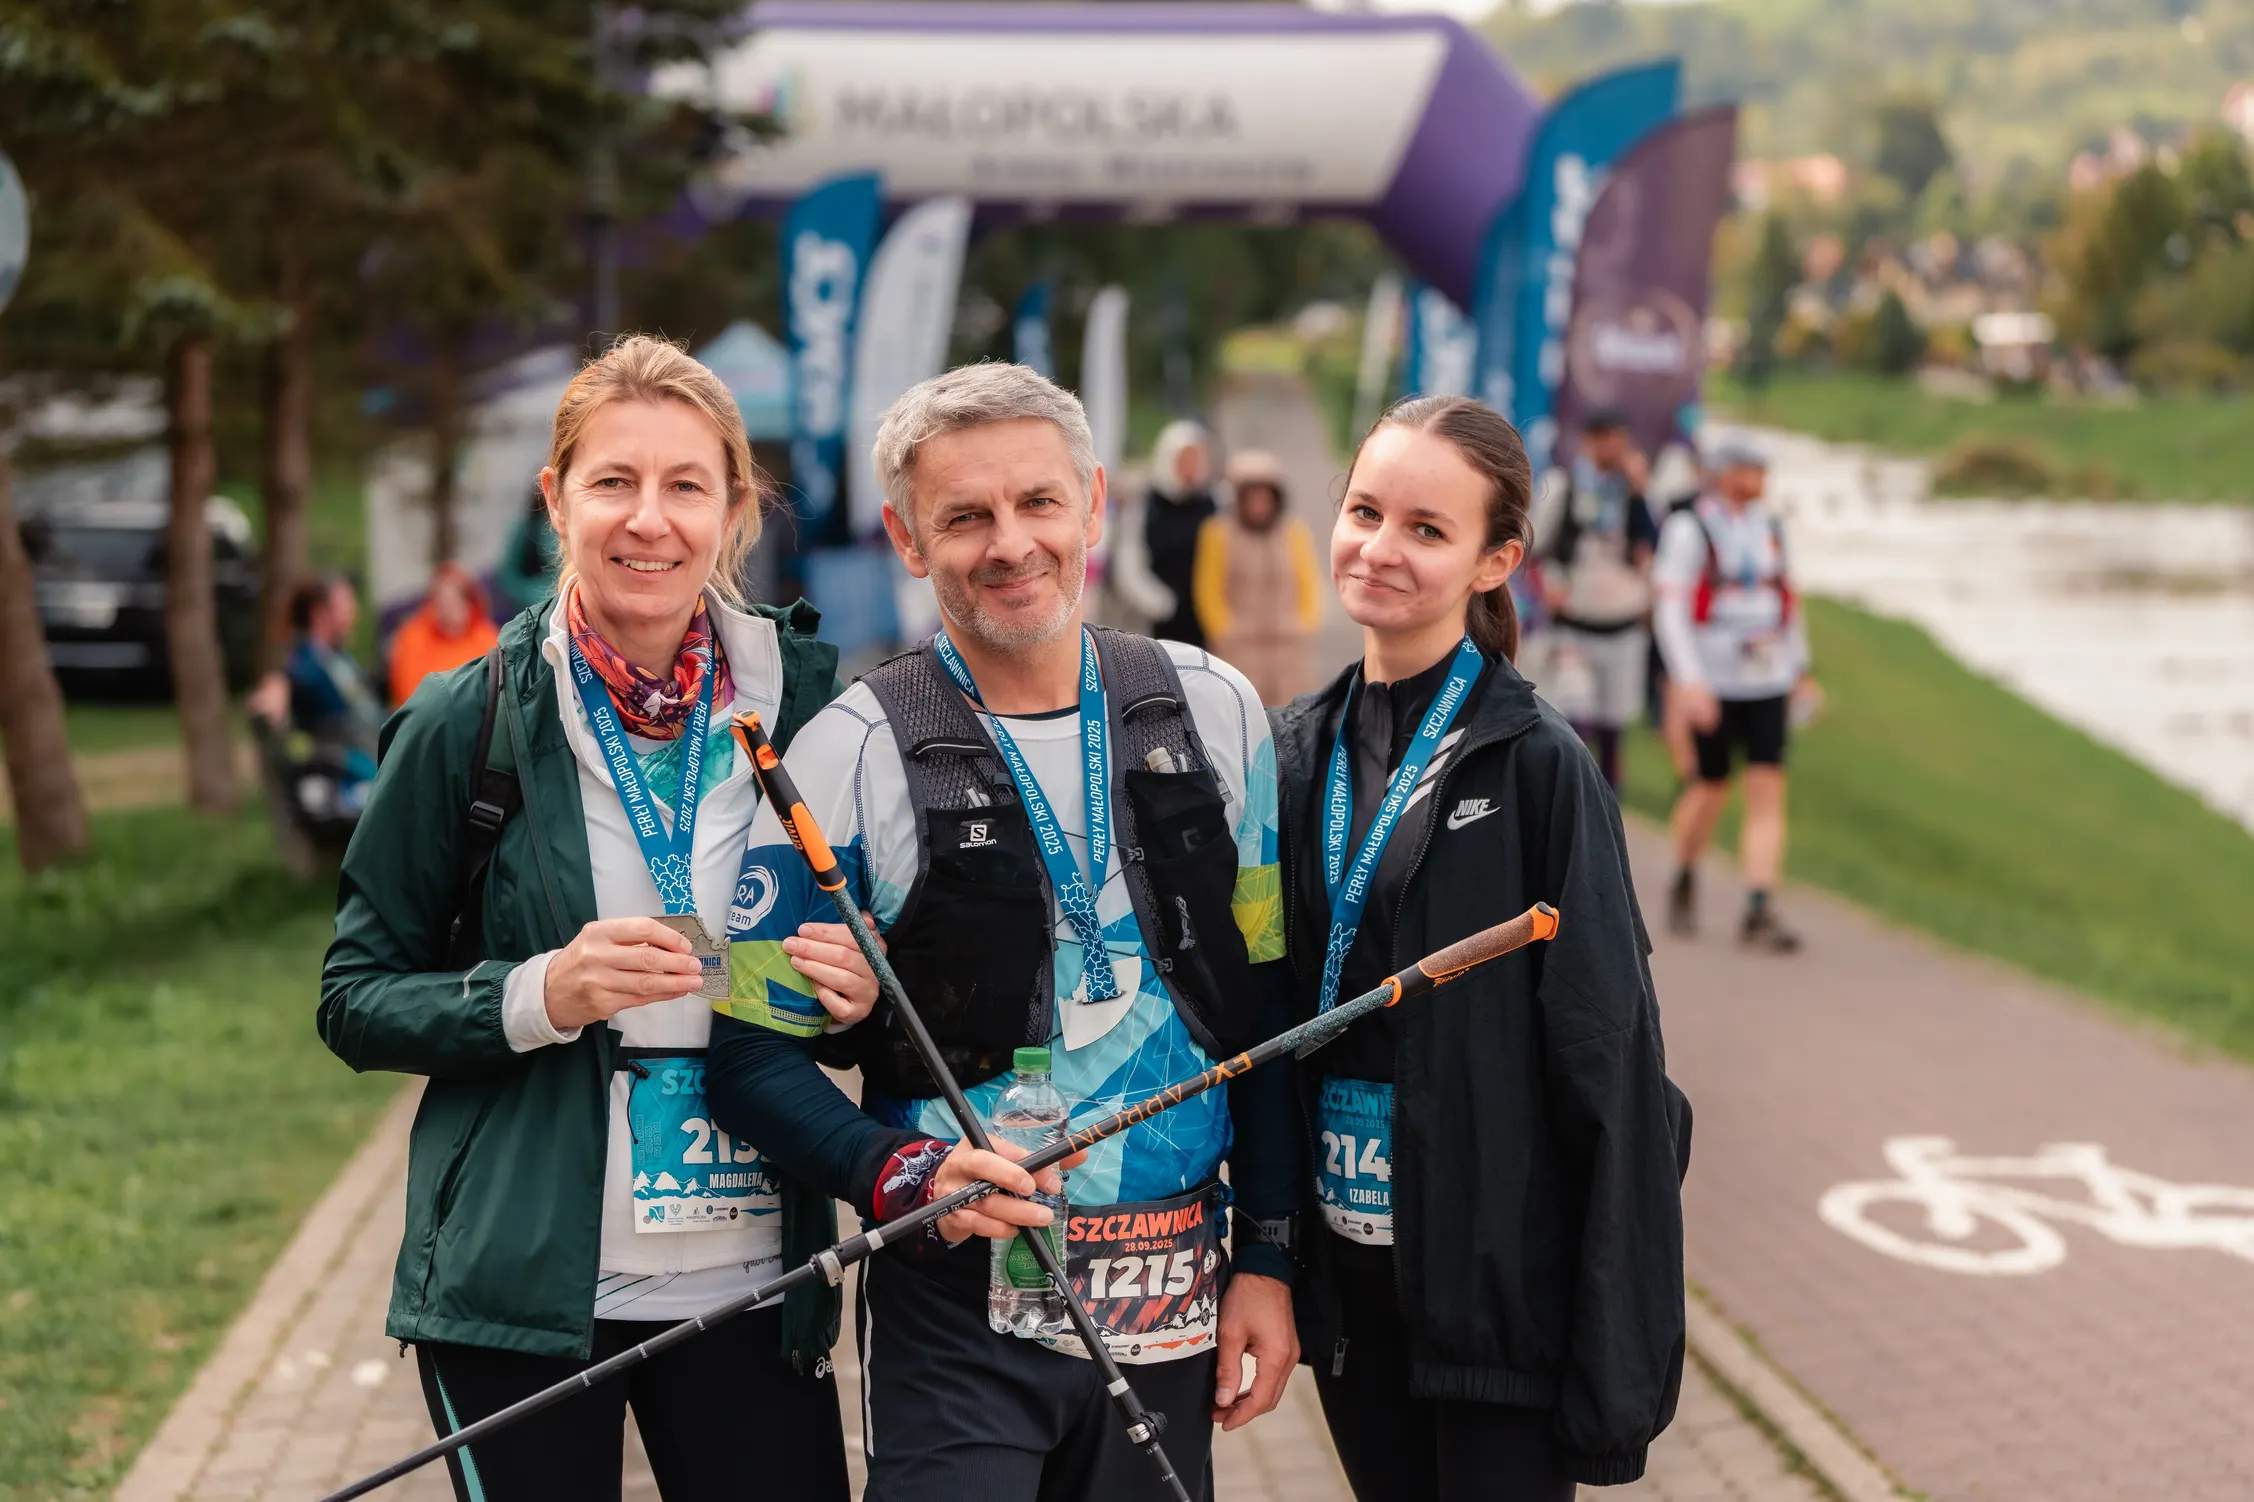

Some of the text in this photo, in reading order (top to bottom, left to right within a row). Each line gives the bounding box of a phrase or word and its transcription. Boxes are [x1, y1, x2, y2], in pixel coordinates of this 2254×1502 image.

[938, 635, 976, 697] SZCZAWNICA
[1423, 676, 1467, 739] SZCZAWNICA
[593, 706, 658, 837] PERŁY MAŁOPOLSKI 2025
[679, 700, 708, 834] PERŁY MAŁOPOLSKI 2025
[1087, 720, 1106, 864] PERŁY MAŁOPOLSKI 2025
[1008, 751, 1049, 822] MAŁOPOLSKI
[1039, 823, 1063, 855] 2025
[1329, 745, 1348, 884] PERŁY MAŁOPOLSKI 2025
[1455, 798, 1491, 817] NIKE
[1345, 764, 1418, 904] PERŁY MAŁOPOLSKI 2025
[731, 884, 755, 906] RA
[1345, 1116, 1385, 1129] 28.09.2025
[709, 1172, 763, 1189] MAGDALENA
[1321, 1130, 1392, 1182] 214
[1067, 1200, 1203, 1242] SZCZAWNICA
[1349, 1188, 1390, 1206] IZABELA
[1124, 1239, 1173, 1252] 28.09.2025
[1088, 1249, 1194, 1299] 1215
